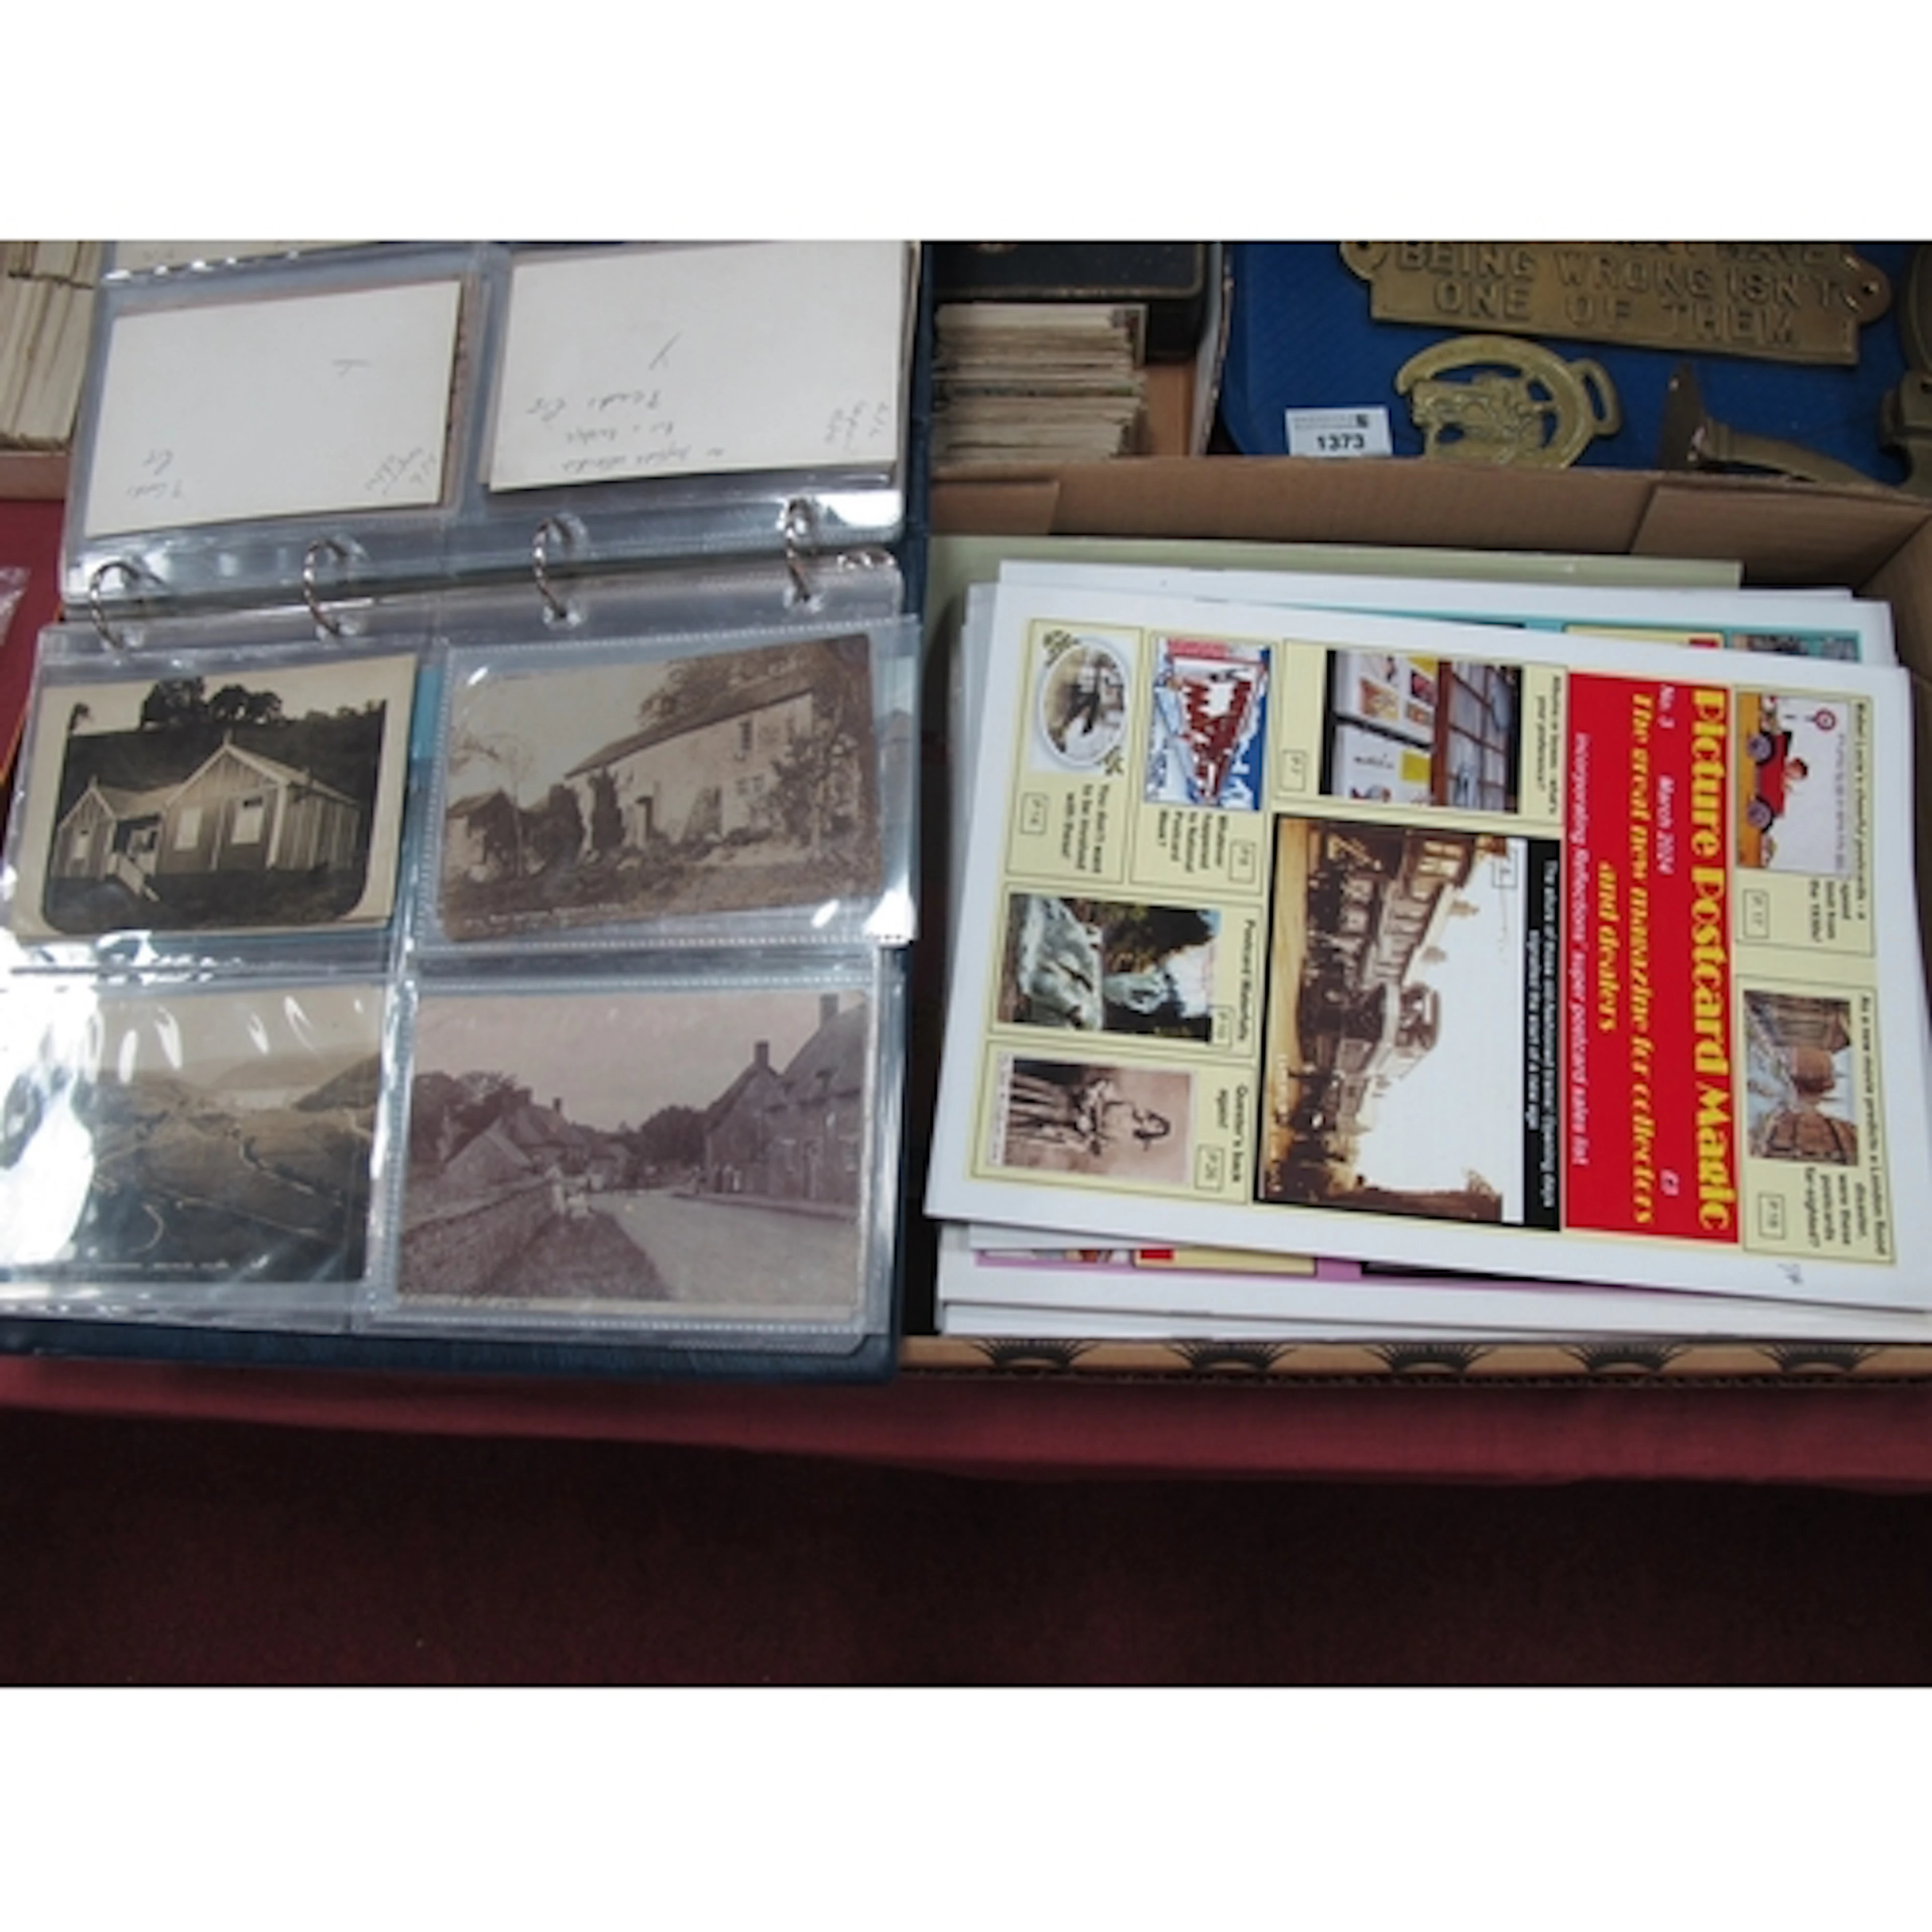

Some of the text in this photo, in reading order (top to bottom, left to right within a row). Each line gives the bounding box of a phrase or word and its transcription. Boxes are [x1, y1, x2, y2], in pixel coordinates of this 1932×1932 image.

[1397, 245, 1536, 282] BEING
[1554, 251, 1712, 298] WRONG
[1432, 278, 1800, 347] ONE OF THEM
[1316, 433, 1365, 451] 1373
[1657, 775, 1675, 829] March
[1544, 860, 1559, 885] The
[1240, 920, 1256, 975] Postcard
[1597, 861, 1624, 1033] and dealers
[1629, 693, 1656, 1224] The great new magazine for collectors
[1689, 689, 1736, 1231] Picture Postcard Magic
[1568, 950, 1587, 1001] super
[1568, 1001, 1589, 1087] postcard
[1571, 1084, 1589, 1133] sales
[1232, 1151, 1245, 1182] back
